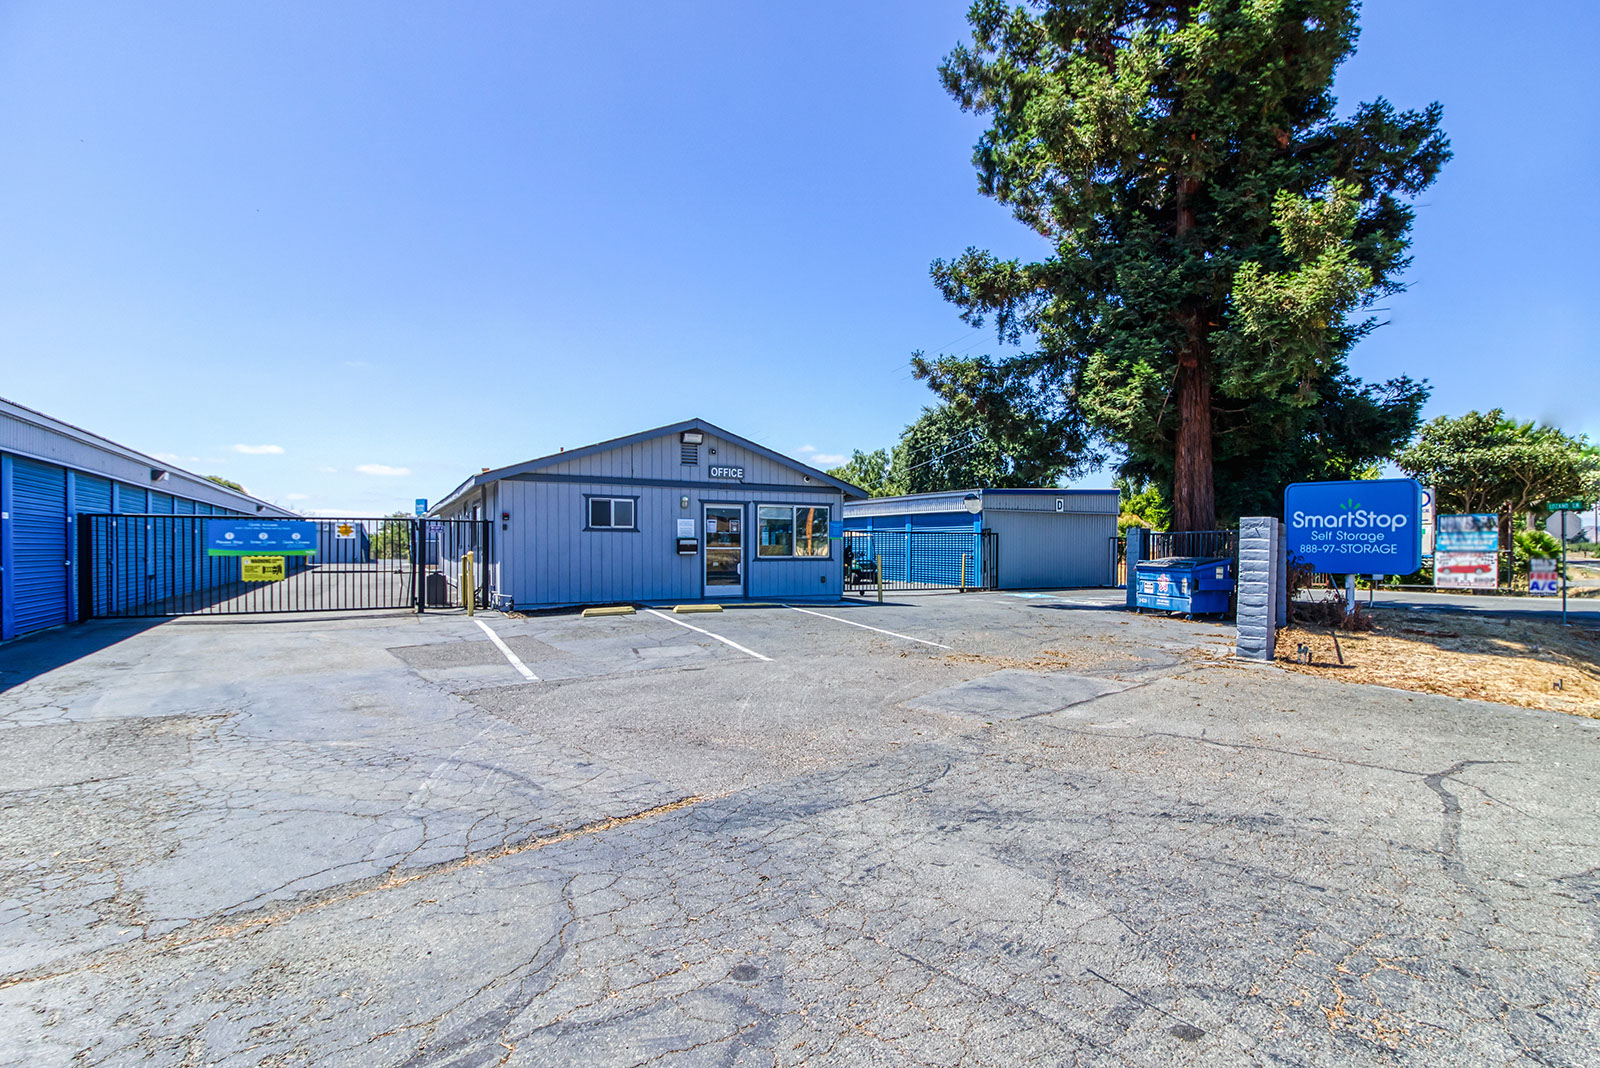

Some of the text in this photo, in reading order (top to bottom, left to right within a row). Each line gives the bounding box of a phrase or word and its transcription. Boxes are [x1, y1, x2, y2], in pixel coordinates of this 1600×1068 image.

[710, 466, 744, 478] OFFICE
[1057, 500, 1063, 510] D
[1292, 510, 1408, 532] SmartStop
[1311, 530, 1385, 543] Self Storage
[1299, 543, 1398, 555] 888-97-STORAGE
[1529, 581, 1557, 591] A/C
